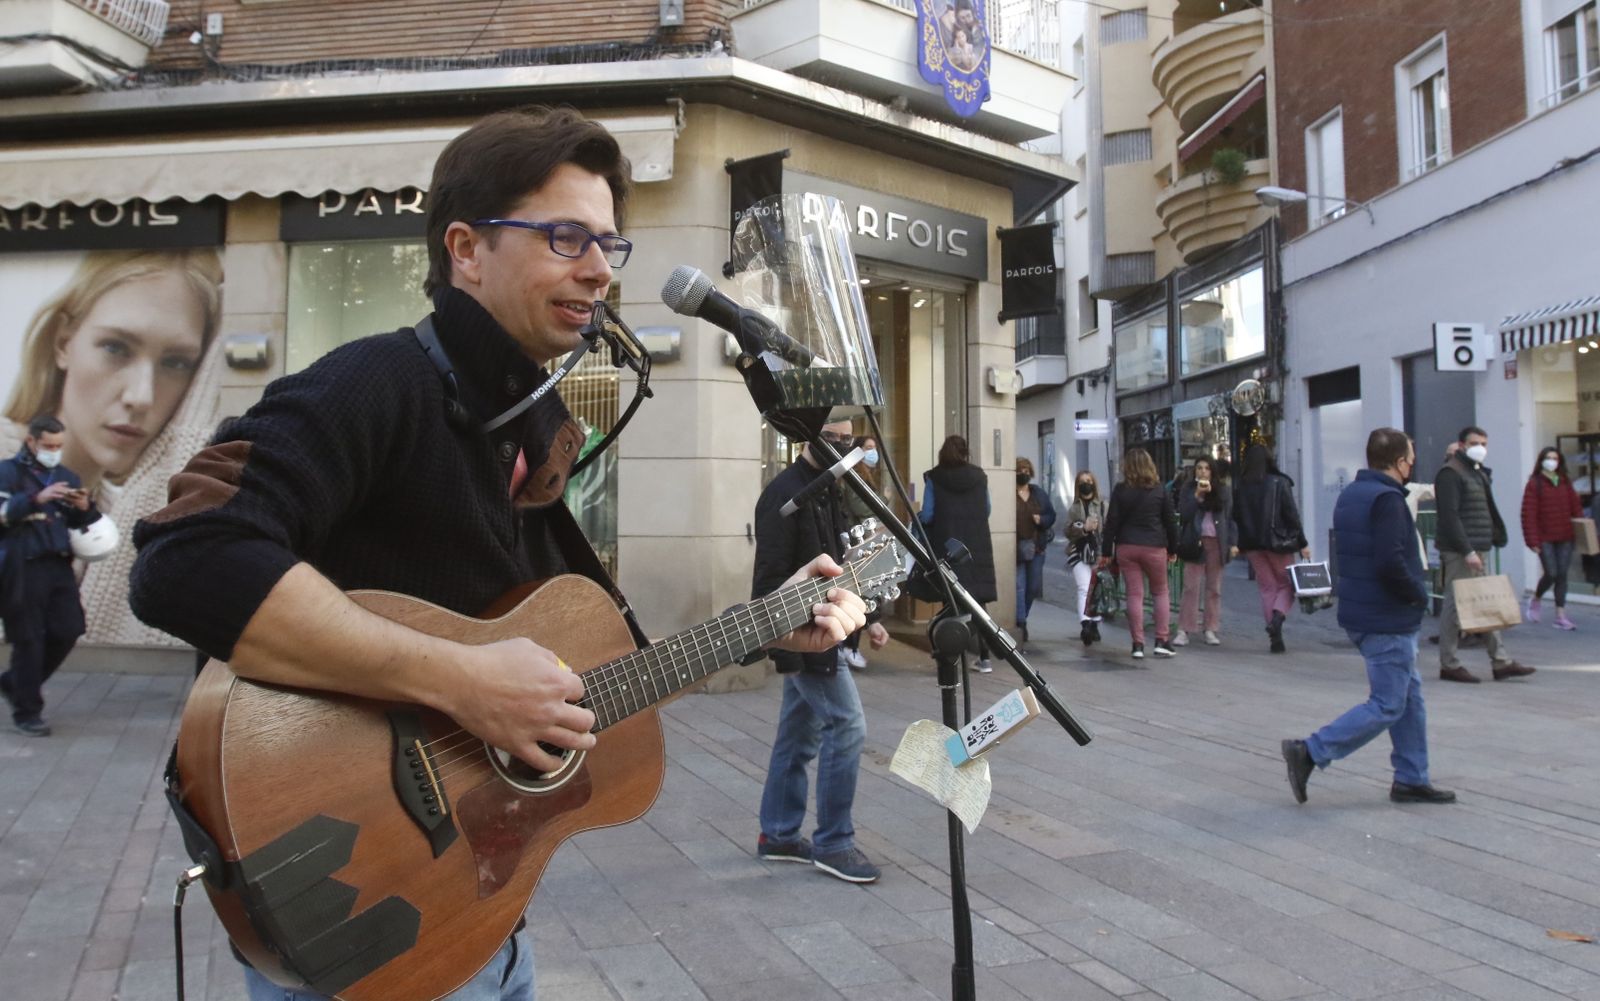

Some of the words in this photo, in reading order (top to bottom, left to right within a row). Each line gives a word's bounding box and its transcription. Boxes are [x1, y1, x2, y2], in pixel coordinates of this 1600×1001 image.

[803, 192, 968, 257] PARFOIS
[1006, 265, 1053, 278] PARFOIS
[531, 367, 566, 400] HOHNER
